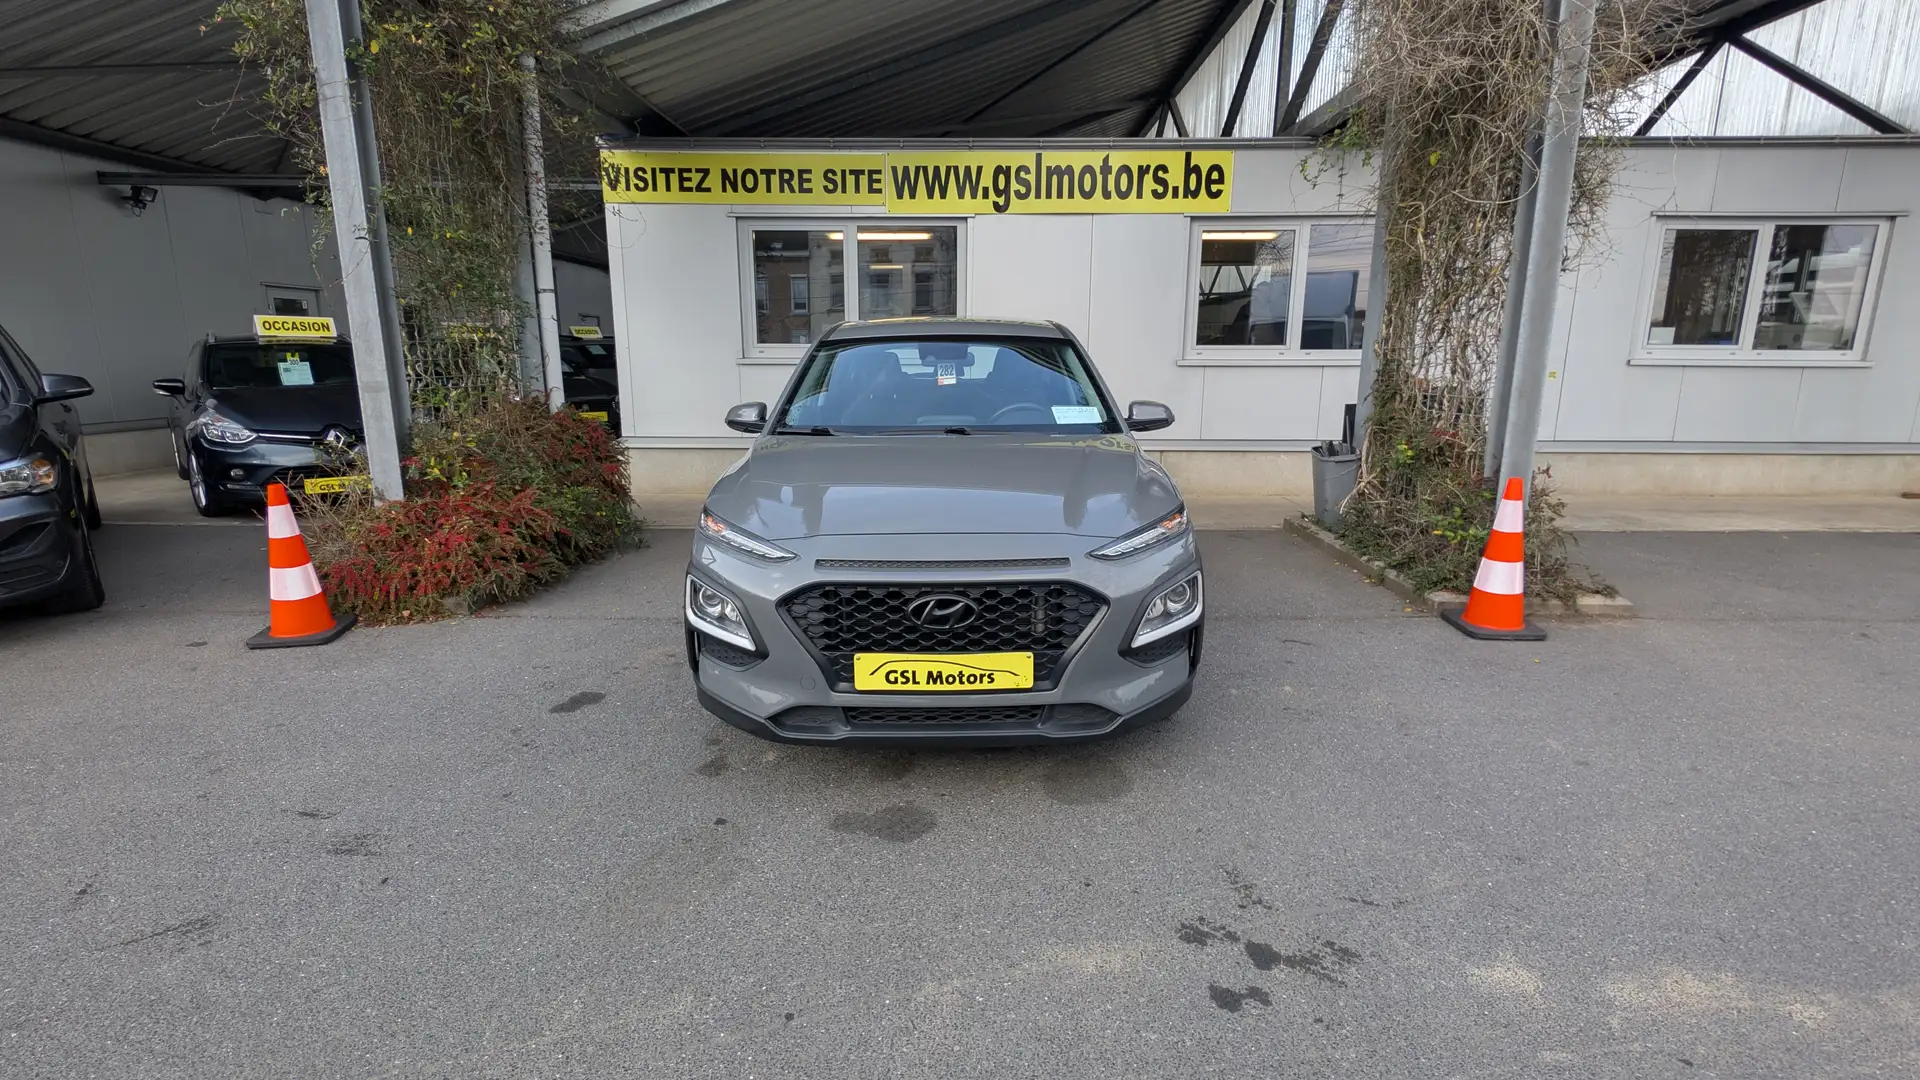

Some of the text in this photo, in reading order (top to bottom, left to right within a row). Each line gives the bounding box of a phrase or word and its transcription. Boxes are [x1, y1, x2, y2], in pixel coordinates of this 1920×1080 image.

[603, 166, 883, 195] VISITEZ NOTRE SITE
[891, 152, 1225, 213] www.gslmotors.be
[262, 320, 331, 332] OCCASION
[939, 364, 955, 377] 282
[884, 669, 995, 685] GSL Motors
